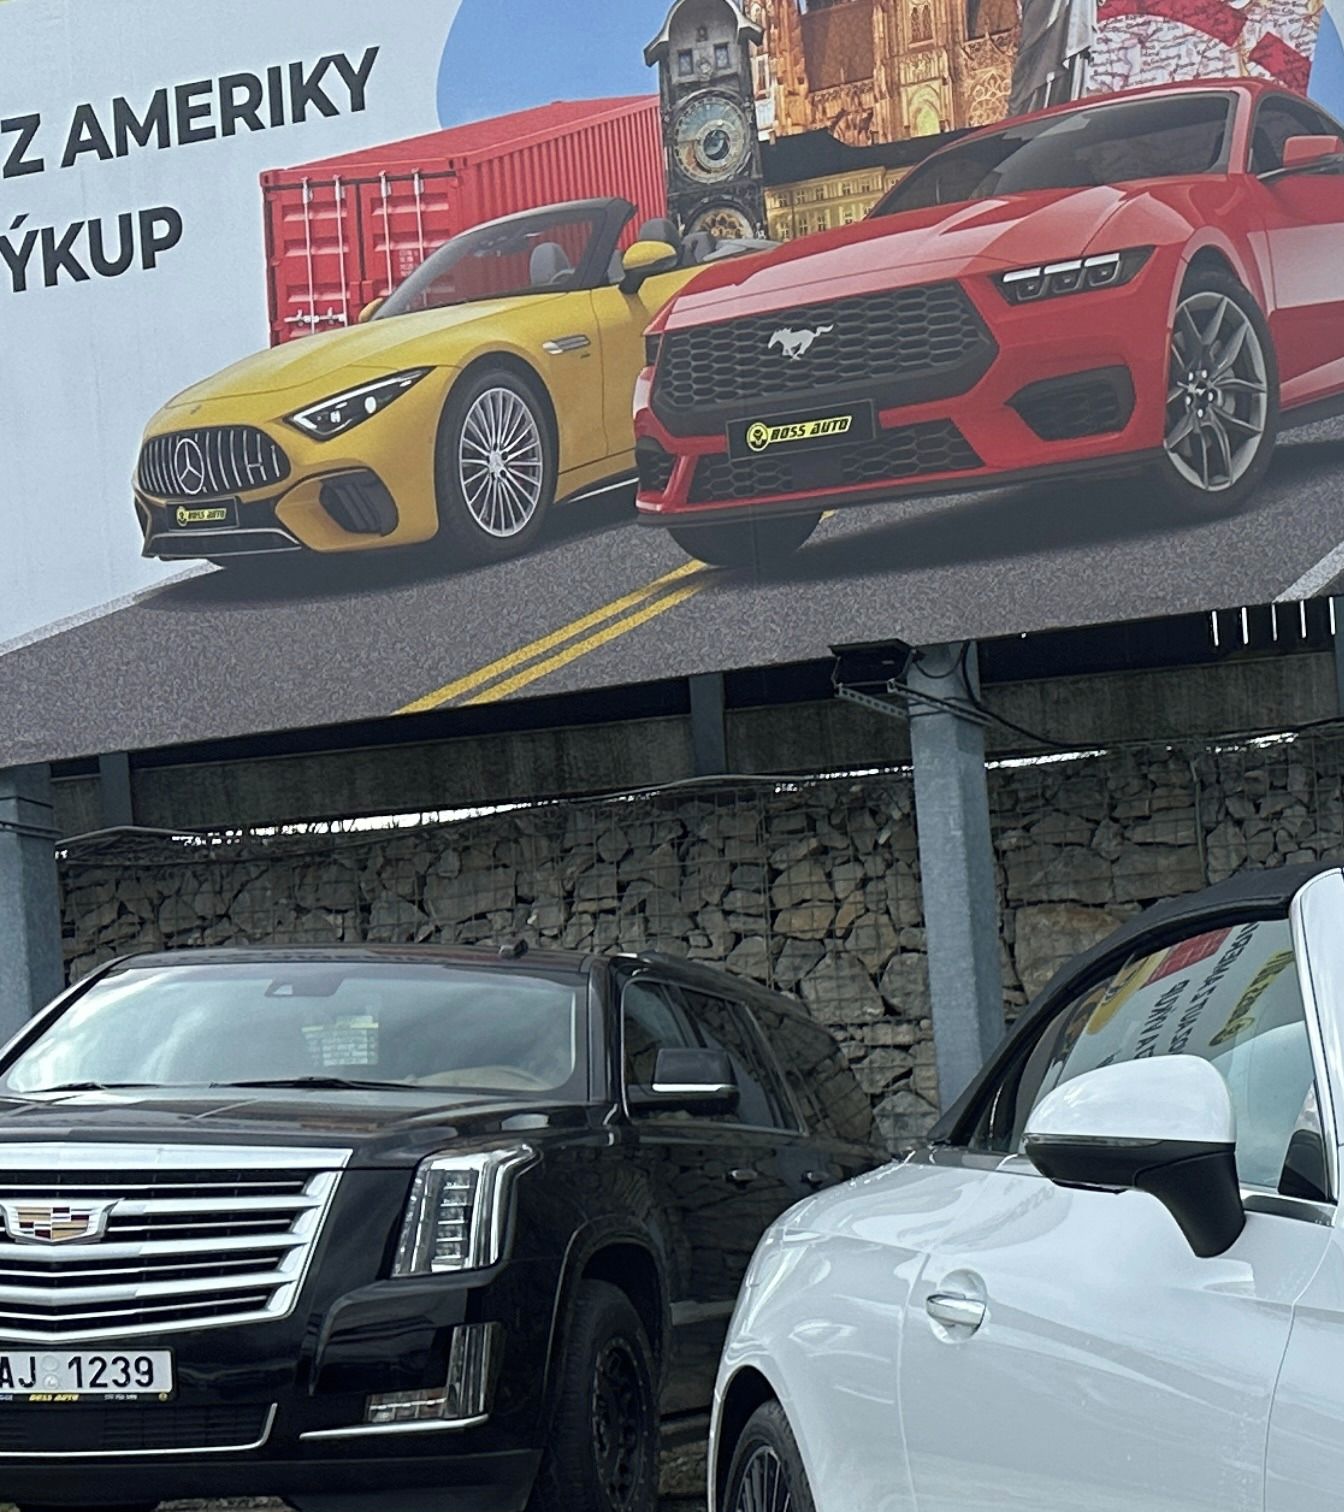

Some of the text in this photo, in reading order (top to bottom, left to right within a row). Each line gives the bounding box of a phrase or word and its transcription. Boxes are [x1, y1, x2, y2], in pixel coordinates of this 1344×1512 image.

[1, 46, 381, 179] Z AMERIKY
[770, 418, 849, 440] BOSS AUTO
[67, 1355, 154, 1388] 1239
